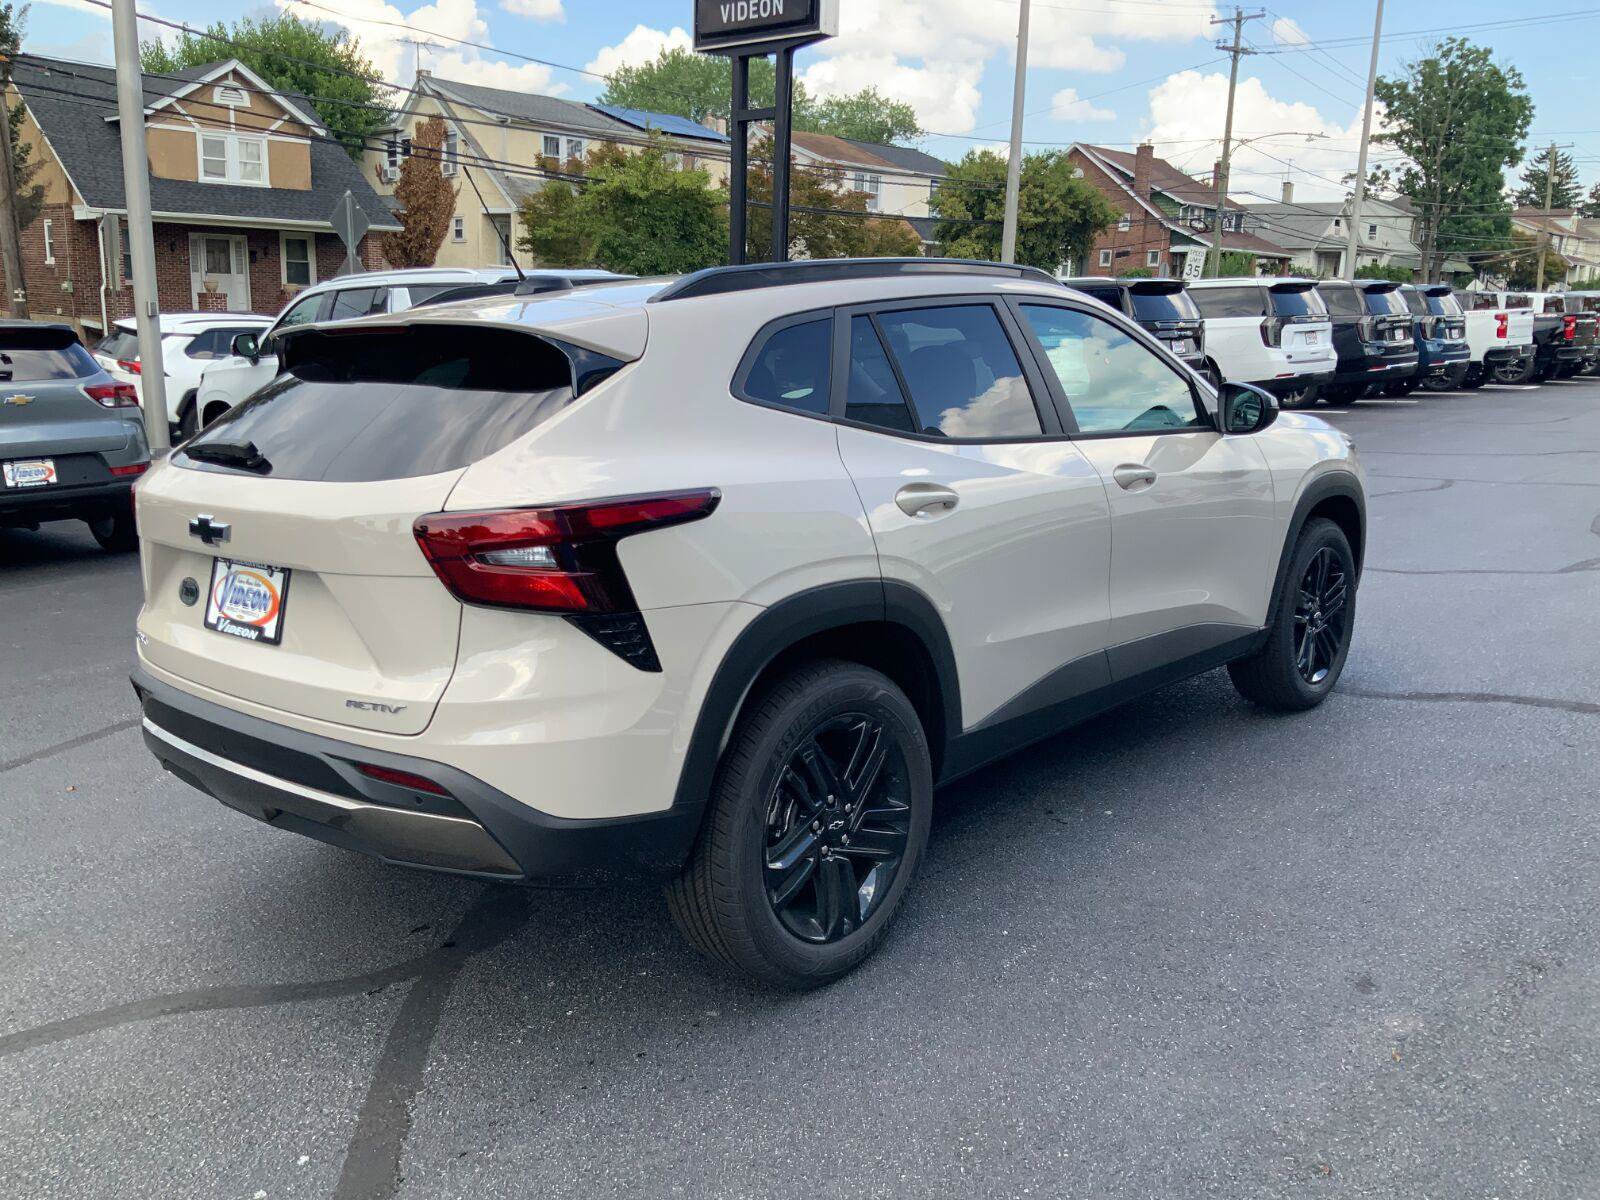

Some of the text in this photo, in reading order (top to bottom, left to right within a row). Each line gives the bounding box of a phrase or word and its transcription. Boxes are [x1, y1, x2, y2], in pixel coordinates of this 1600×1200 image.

[720, 0, 784, 24] VIDEON
[1185, 263, 1201, 278] 35
[219, 569, 272, 614] VIDEON
[217, 617, 259, 640] VIDEON
[345, 699, 408, 714] ACTIV
